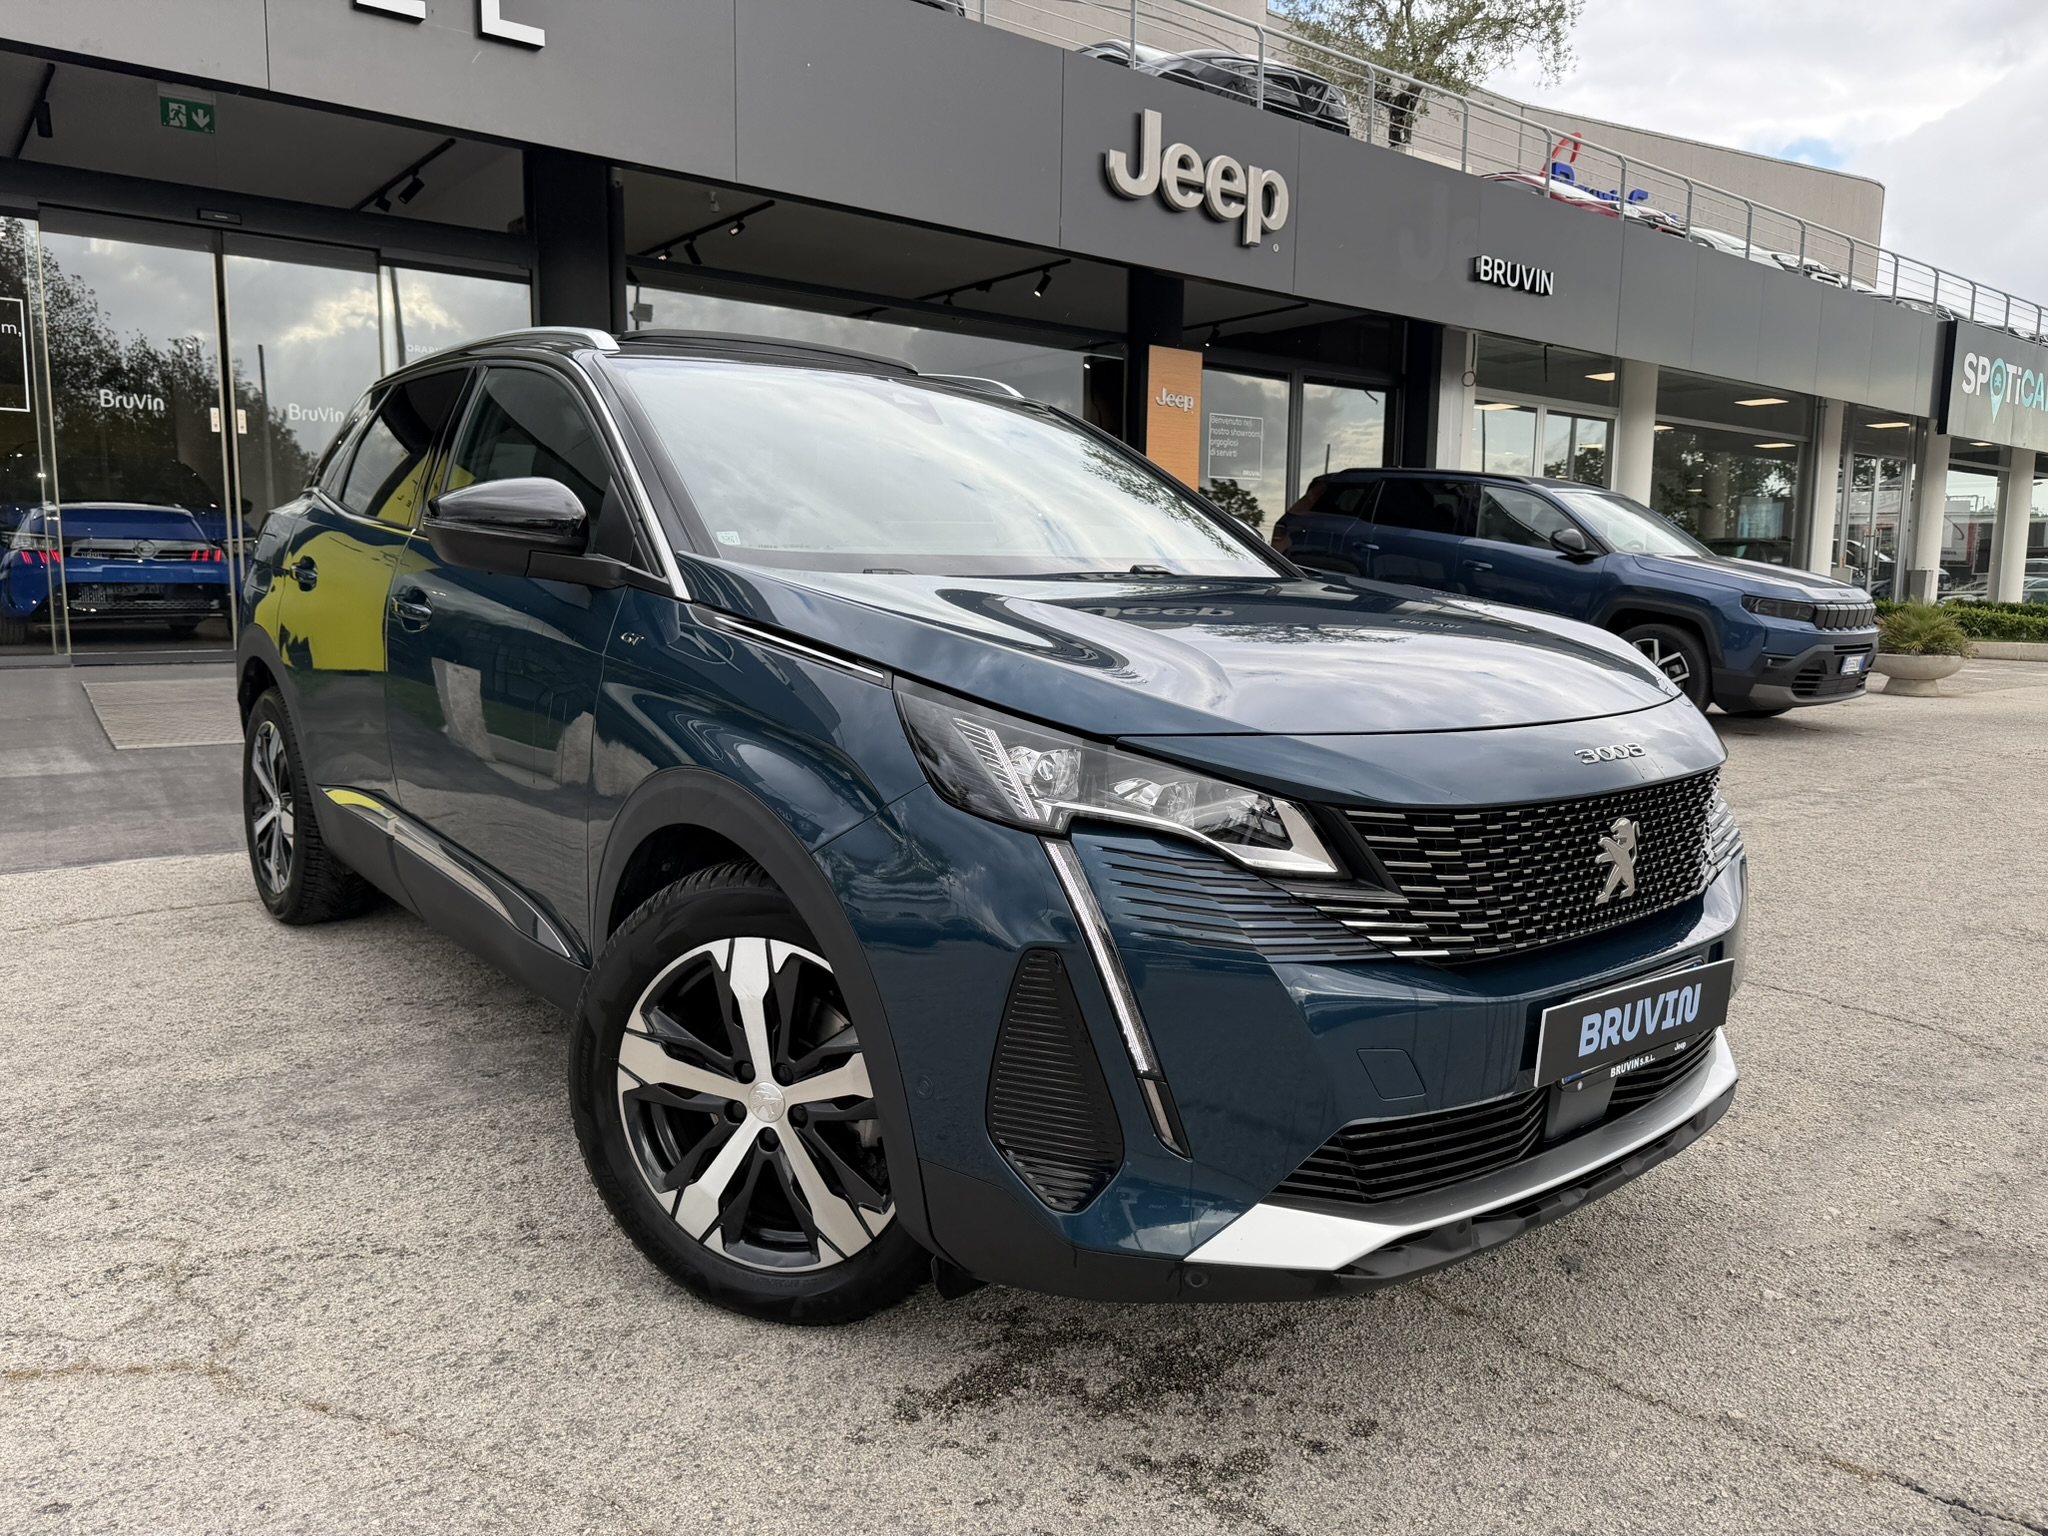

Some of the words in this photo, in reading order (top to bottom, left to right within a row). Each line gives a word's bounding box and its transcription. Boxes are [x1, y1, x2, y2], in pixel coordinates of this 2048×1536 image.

[1106, 108, 1289, 247] Jeep
[1479, 254, 1555, 296] BRUVIN
[100, 388, 165, 411] BruVin
[1155, 387, 1195, 414] Jeep
[288, 403, 345, 423] BruVin
[1574, 742, 1646, 765] 3008
[1578, 983, 1702, 1057] BRUVIN
[1674, 1041, 1687, 1051] Jeep
[1610, 1058, 1640, 1078] BRUVIN
